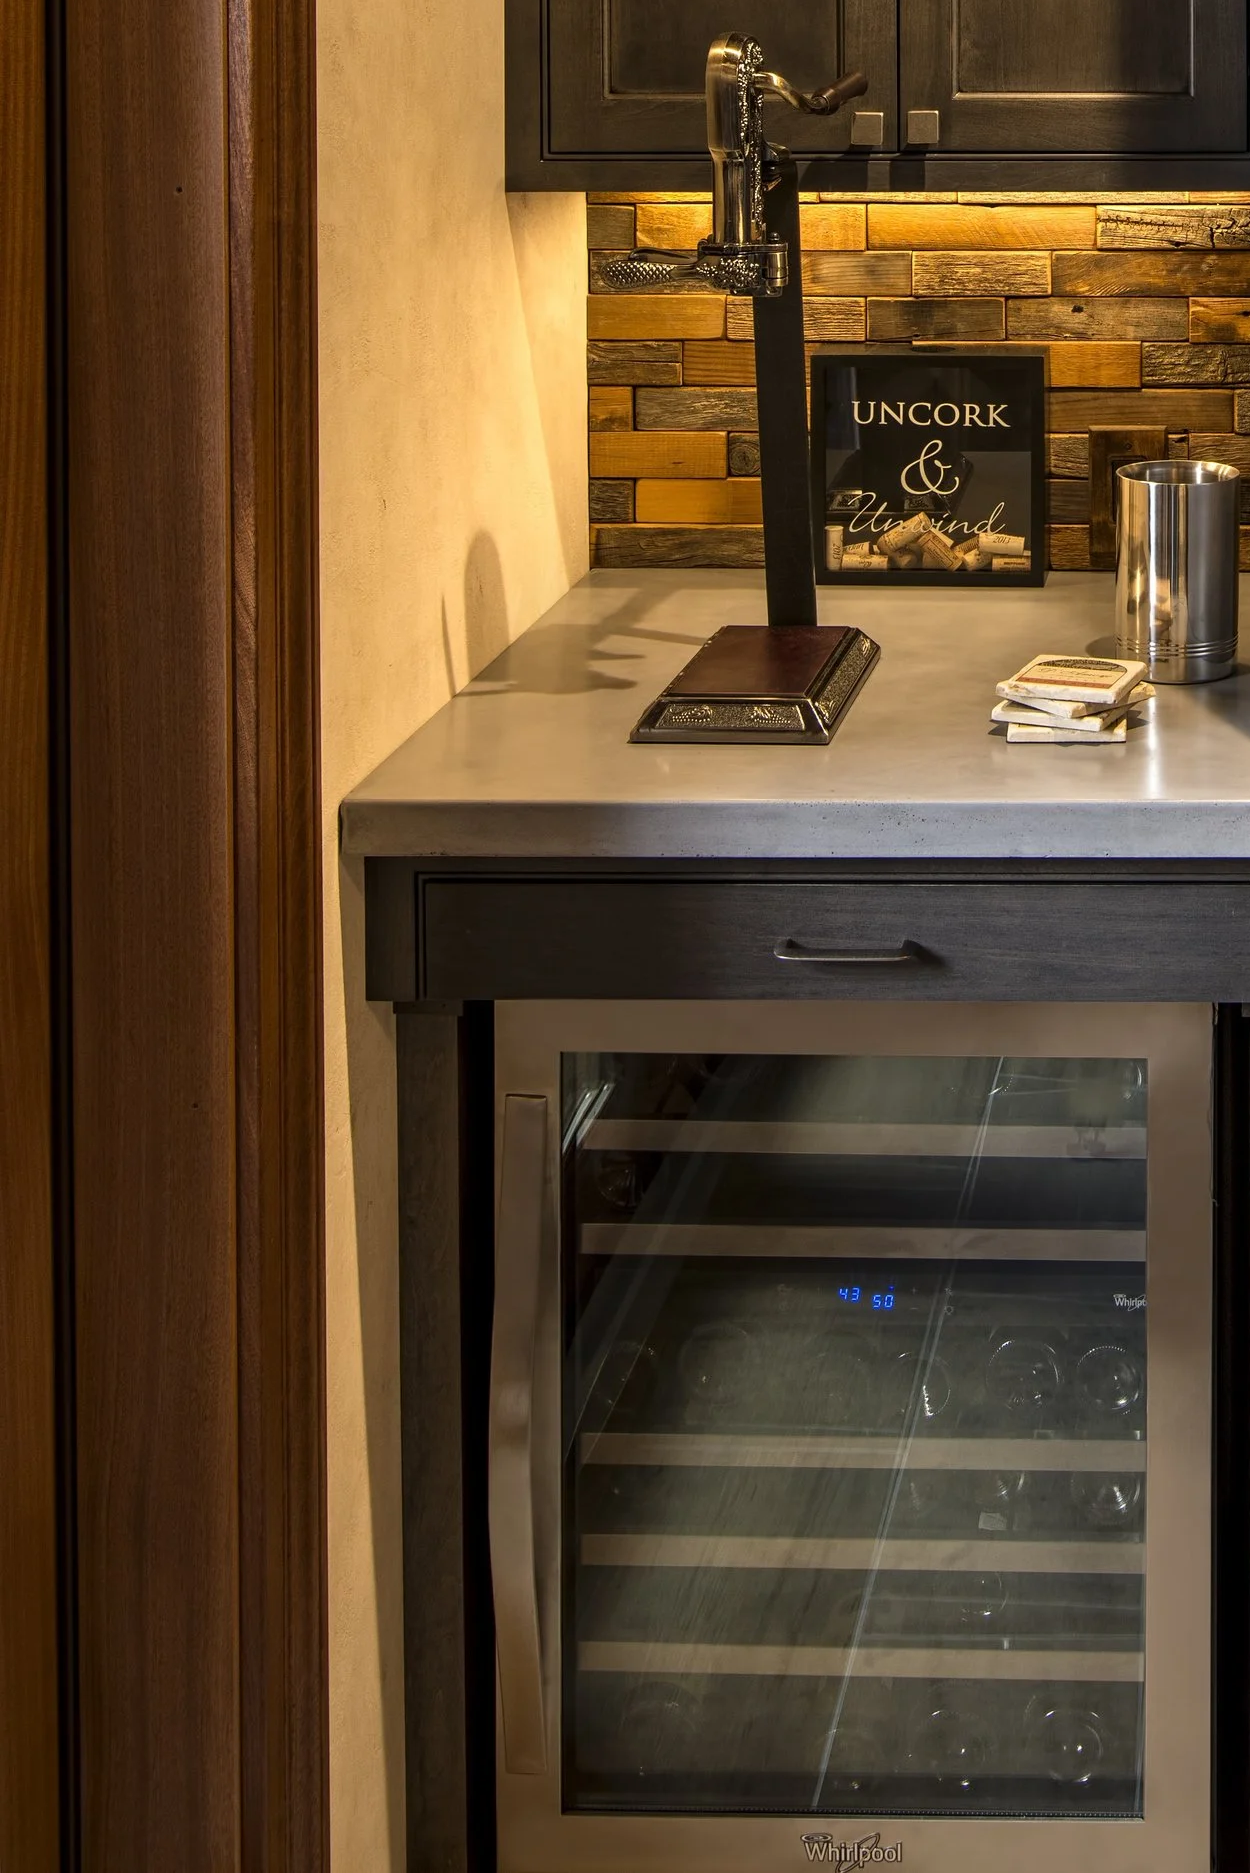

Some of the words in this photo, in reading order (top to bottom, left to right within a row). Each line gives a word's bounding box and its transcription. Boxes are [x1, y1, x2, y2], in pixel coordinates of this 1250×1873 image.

[851, 400, 1012, 428] UNCORK
[900, 439, 960, 495] &
[848, 492, 1007, 535] Unwind
[839, 1287, 860, 1301] 43
[873, 1294, 894, 1308] 50
[803, 1841, 903, 1869] Whirlpool
